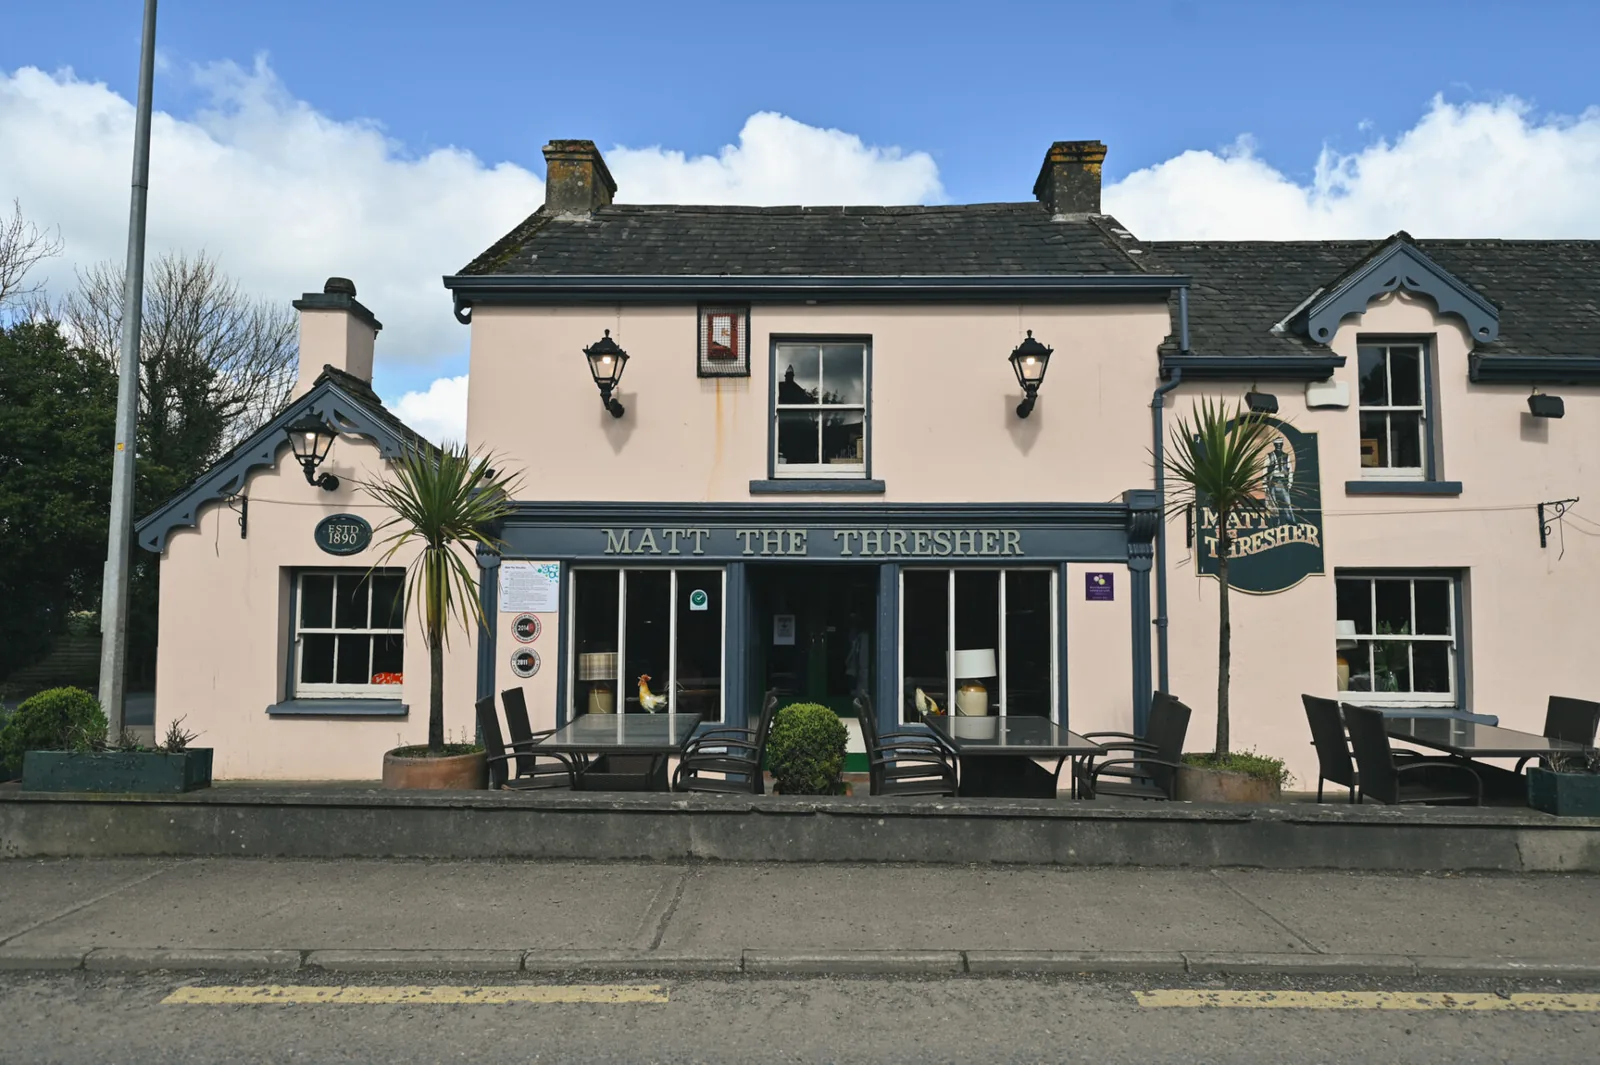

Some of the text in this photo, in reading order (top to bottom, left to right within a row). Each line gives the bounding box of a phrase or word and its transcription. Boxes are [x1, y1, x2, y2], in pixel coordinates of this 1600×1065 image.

[1200, 507, 1271, 529] MATT
[328, 524, 359, 533] ESTD
[328, 533, 356, 544] 1890
[601, 528, 1024, 556] MATT THE THRESHER
